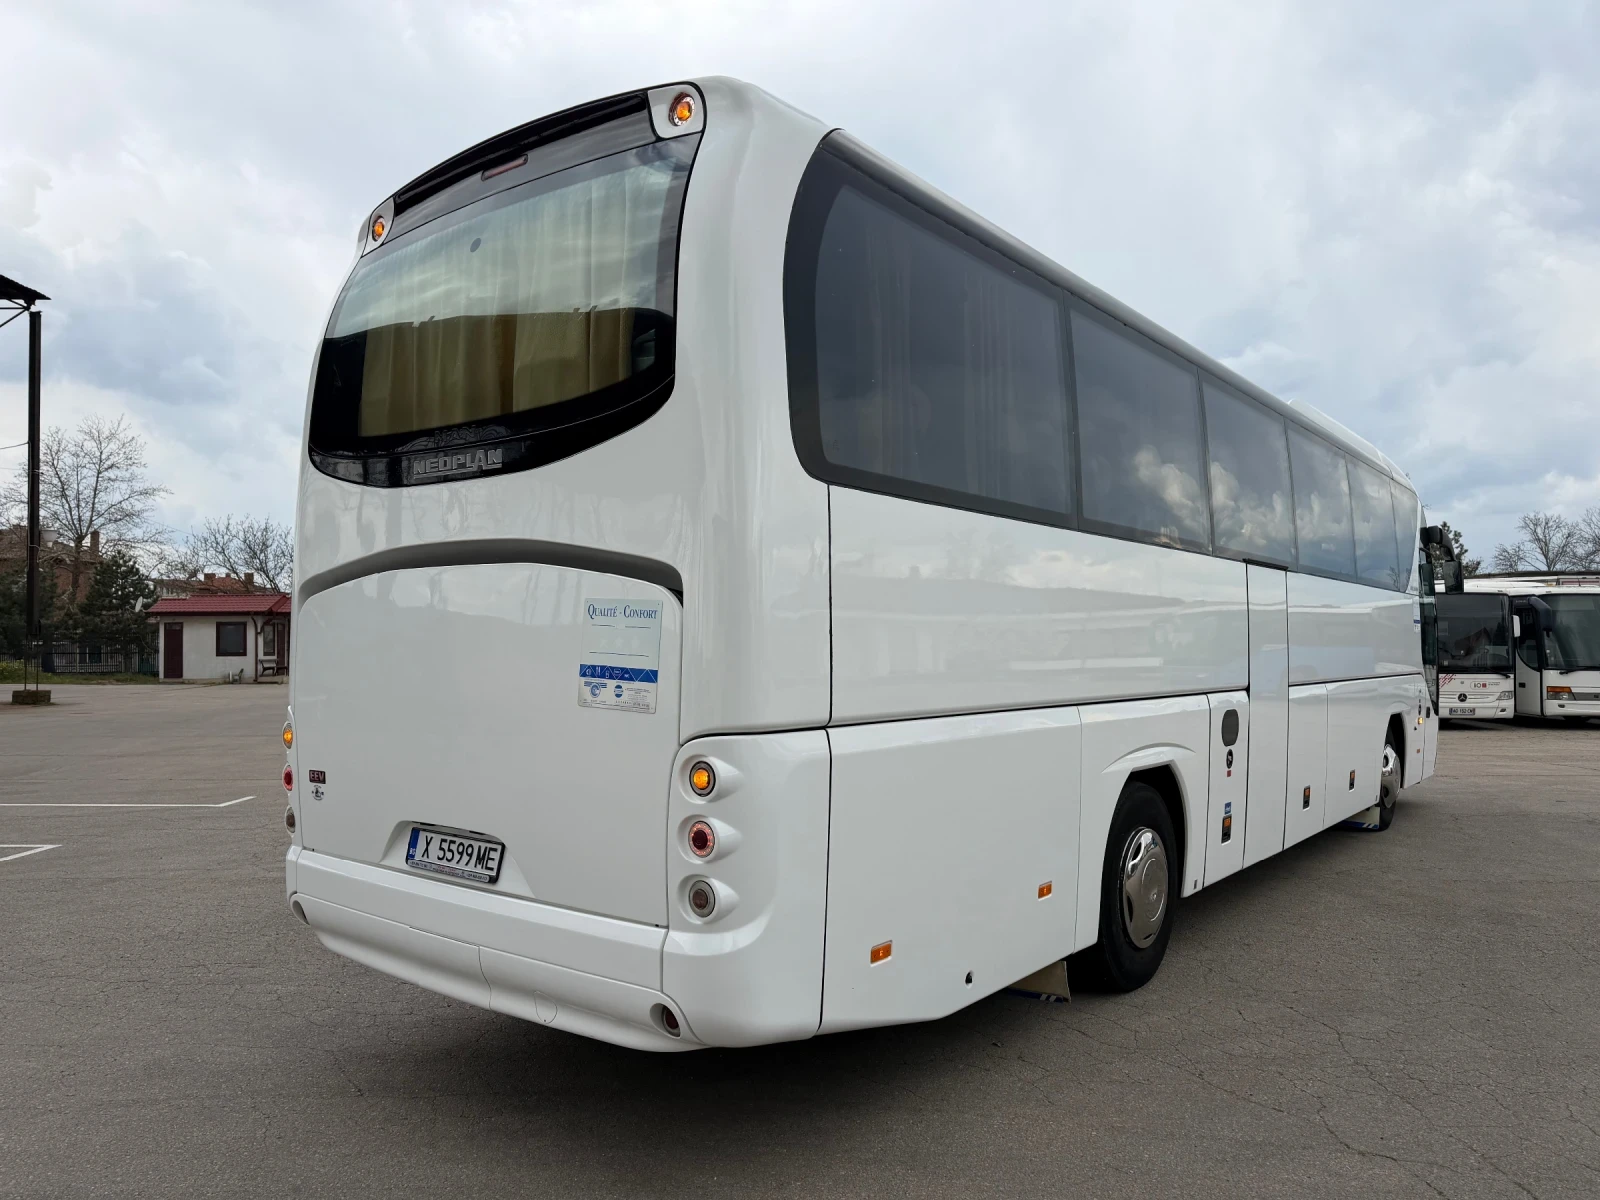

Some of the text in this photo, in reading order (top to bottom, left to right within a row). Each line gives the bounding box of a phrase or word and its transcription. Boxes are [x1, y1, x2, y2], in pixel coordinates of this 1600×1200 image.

[413, 448, 503, 479] NEOPLAN
[623, 604, 658, 620] CONFORT
[310, 771, 325, 781] EEV
[421, 835, 434, 859] X
